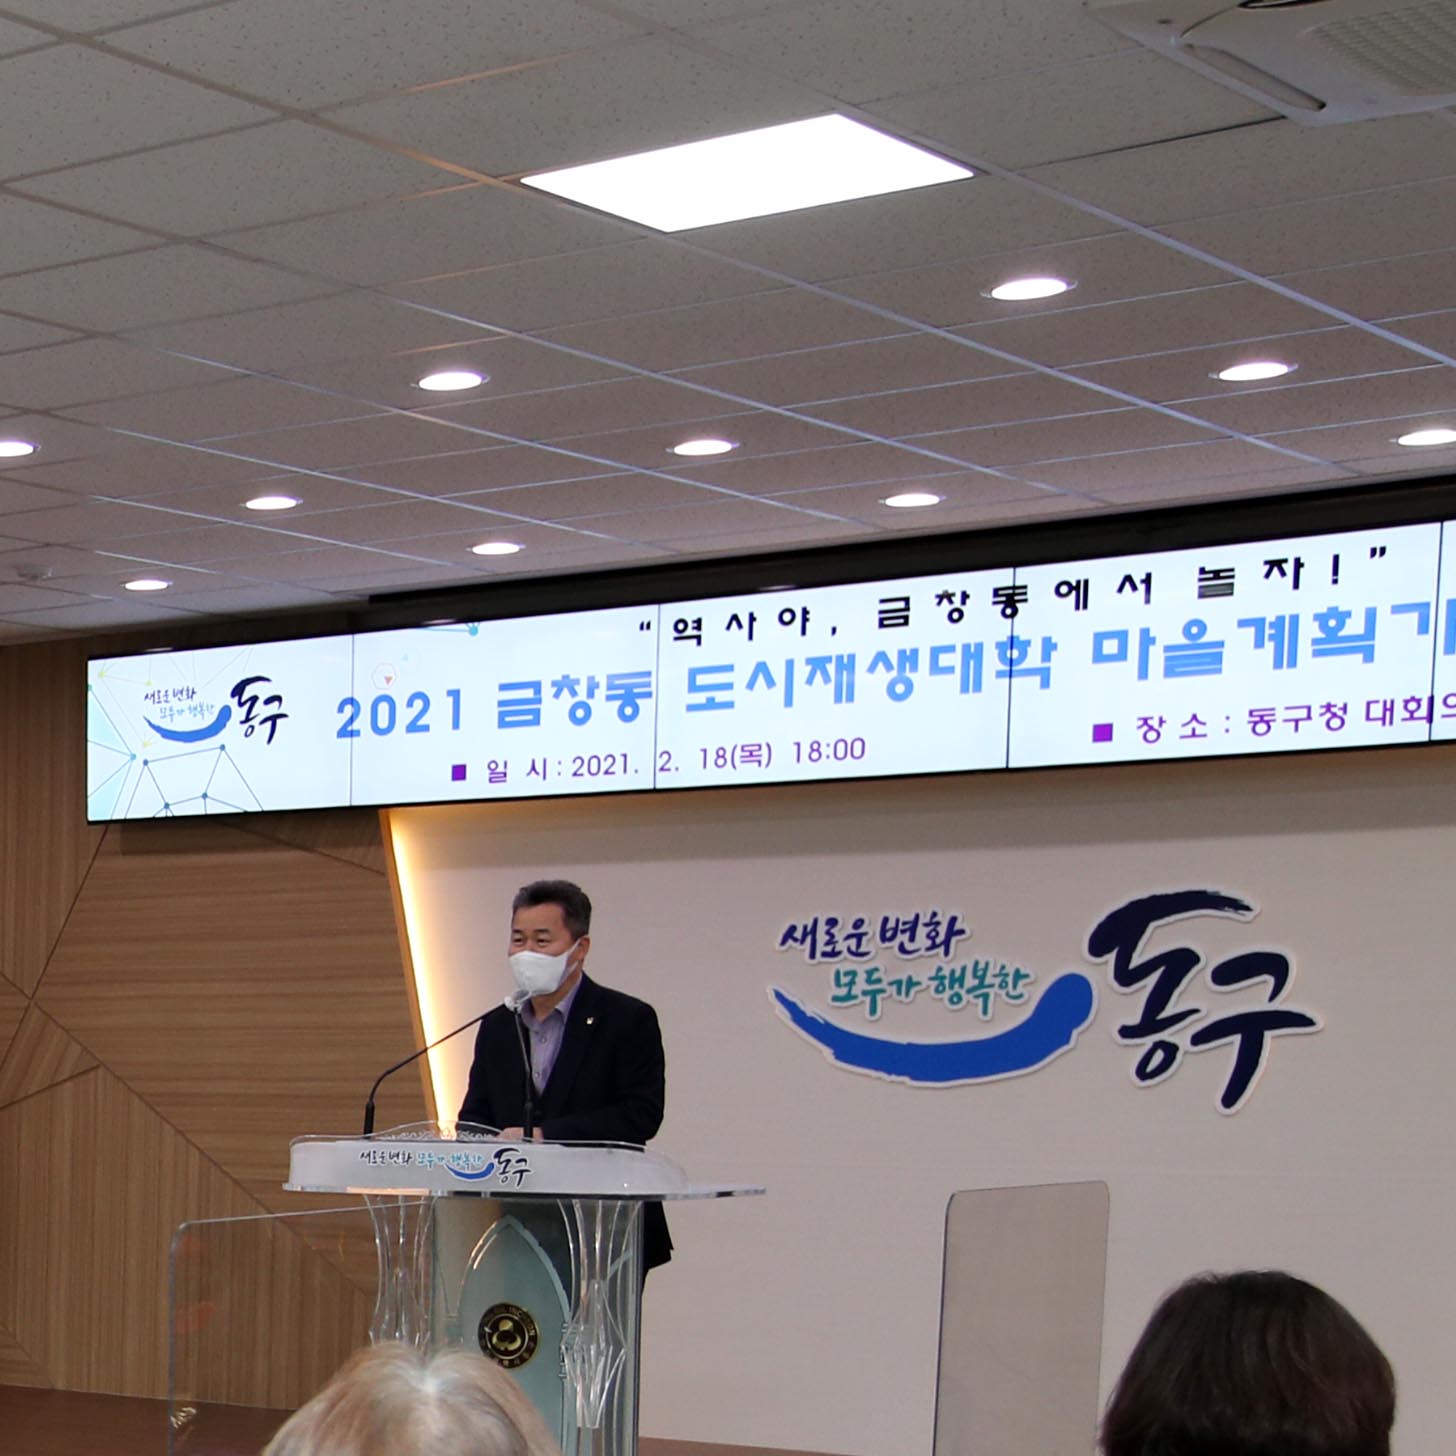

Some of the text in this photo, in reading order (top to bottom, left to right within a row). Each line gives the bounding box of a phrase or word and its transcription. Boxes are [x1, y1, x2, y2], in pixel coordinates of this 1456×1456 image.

[173, 686, 197, 701] 변화
[336, 688, 462, 738] 2021
[496, 671, 653, 729] 금창동
[687, 634, 1058, 713] 도시재생대학
[230, 675, 290, 745] 동구
[1247, 702, 1348, 737] 동구청
[700, 741, 772, 771] 18(목)
[792, 737, 867, 764] 18:00
[780, 913, 966, 959] 새로운 변화
[831, 960, 1031, 1017] 모두가 행복한
[1088, 890, 1317, 1109] 동구
[493, 1147, 531, 1186] 동구
